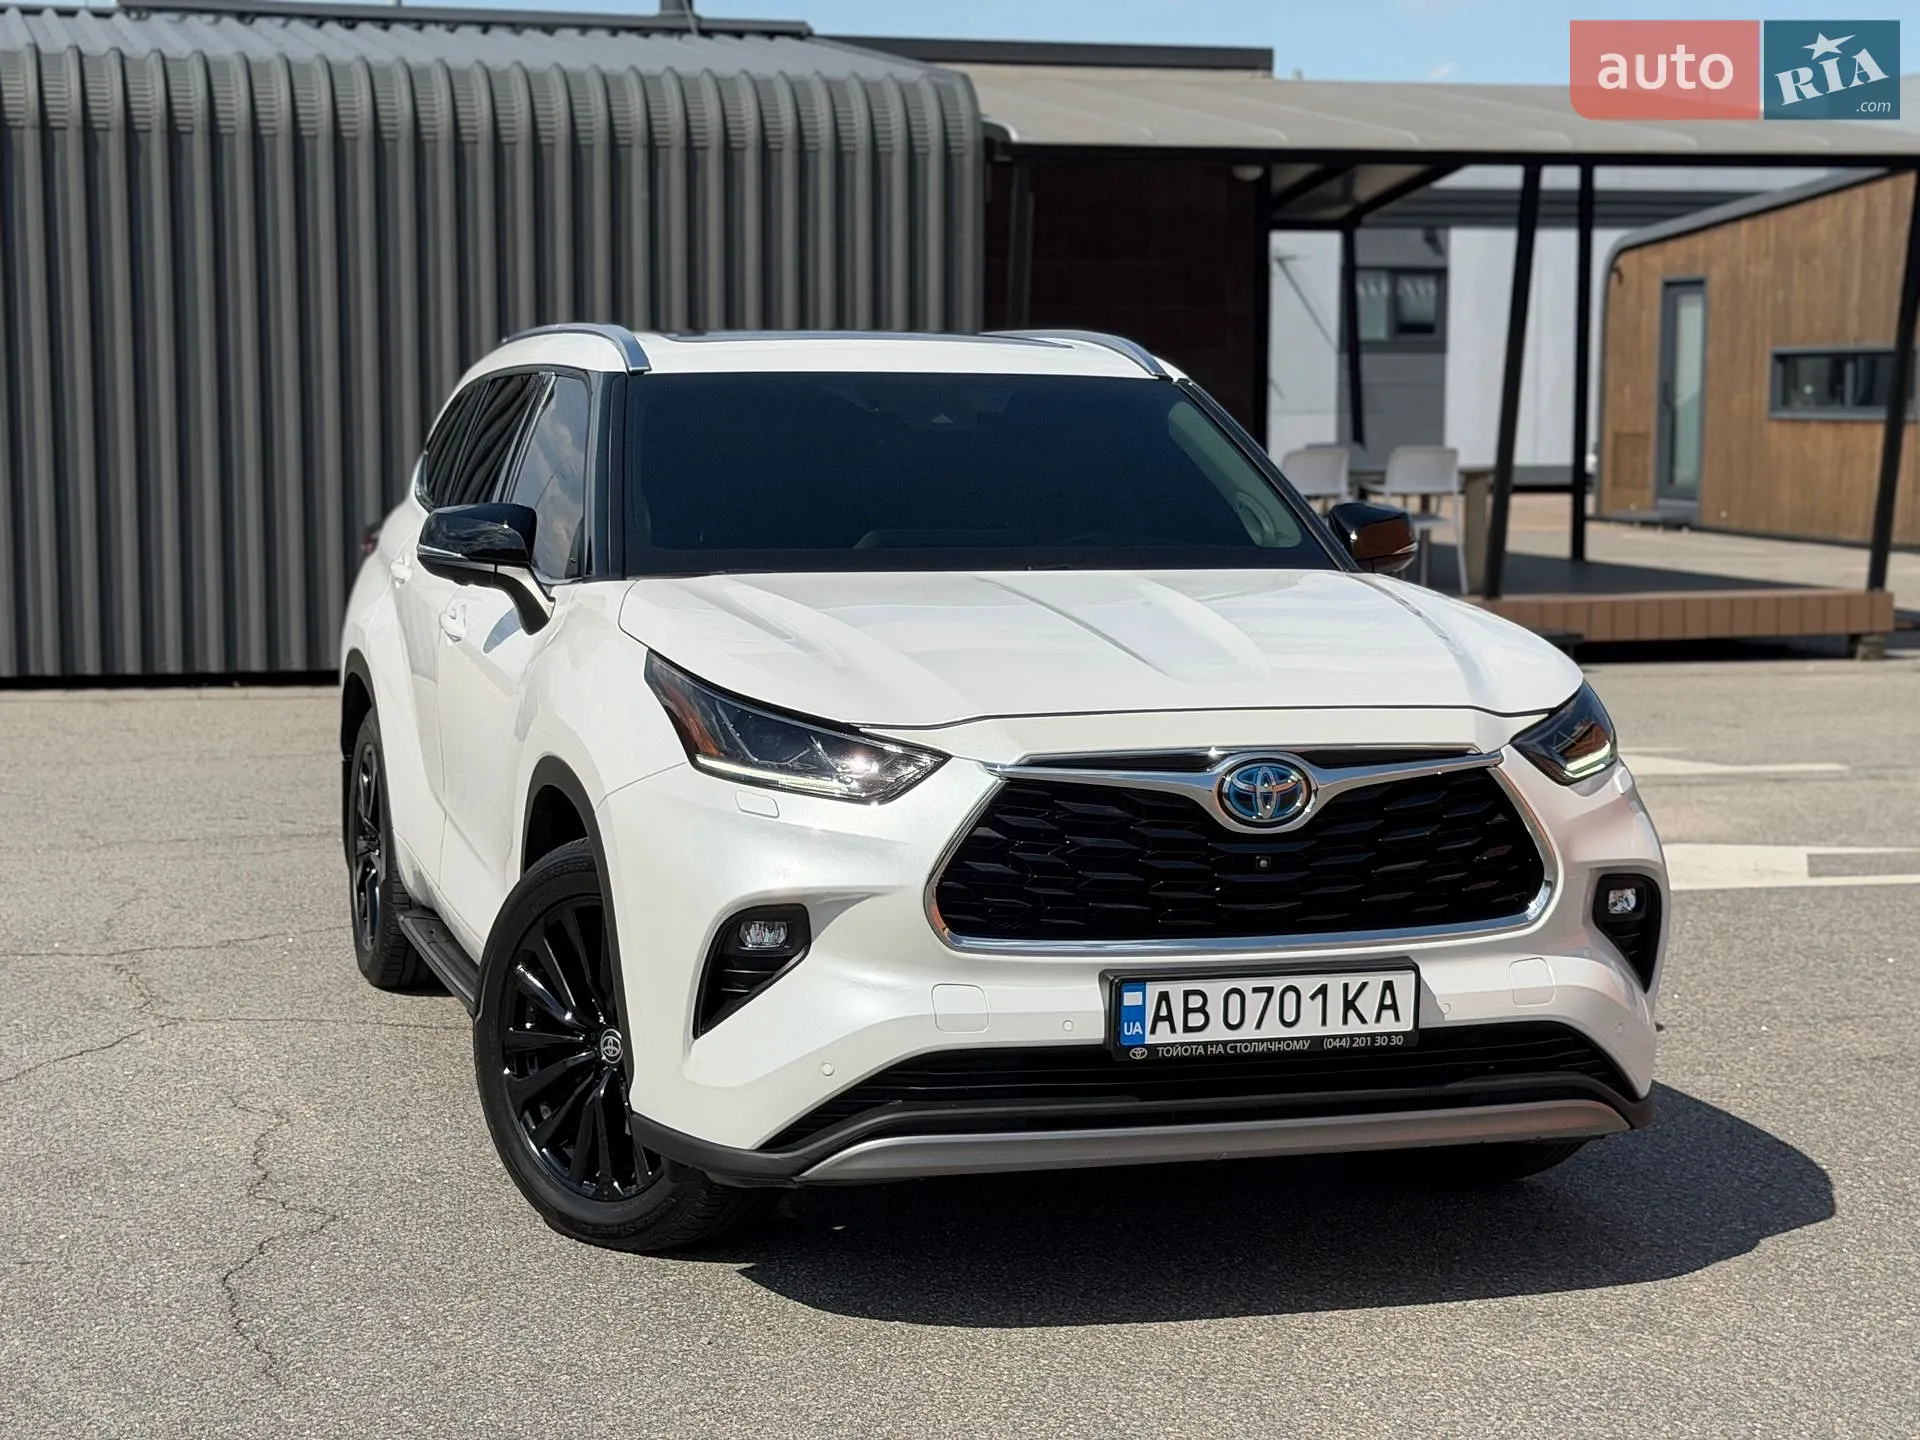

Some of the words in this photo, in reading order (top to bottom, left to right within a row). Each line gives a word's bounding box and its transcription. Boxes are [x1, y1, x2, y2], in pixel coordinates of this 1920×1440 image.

[1149, 990, 1209, 1035] AB
[1222, 984, 1328, 1030] 0701
[1341, 980, 1401, 1026] KA
[1124, 1022, 1143, 1035] UA
[1157, 1044, 1205, 1057] ТОЙОТА
[1207, 1043, 1225, 1055] НА
[1226, 1040, 1311, 1054] СТОЛИЧНОМУ
[1323, 1037, 1350, 1050] (044)
[1352, 1036, 1371, 1048] 201
[1374, 1036, 1388, 1047] 30
[1389, 1035, 1404, 1046] 30
